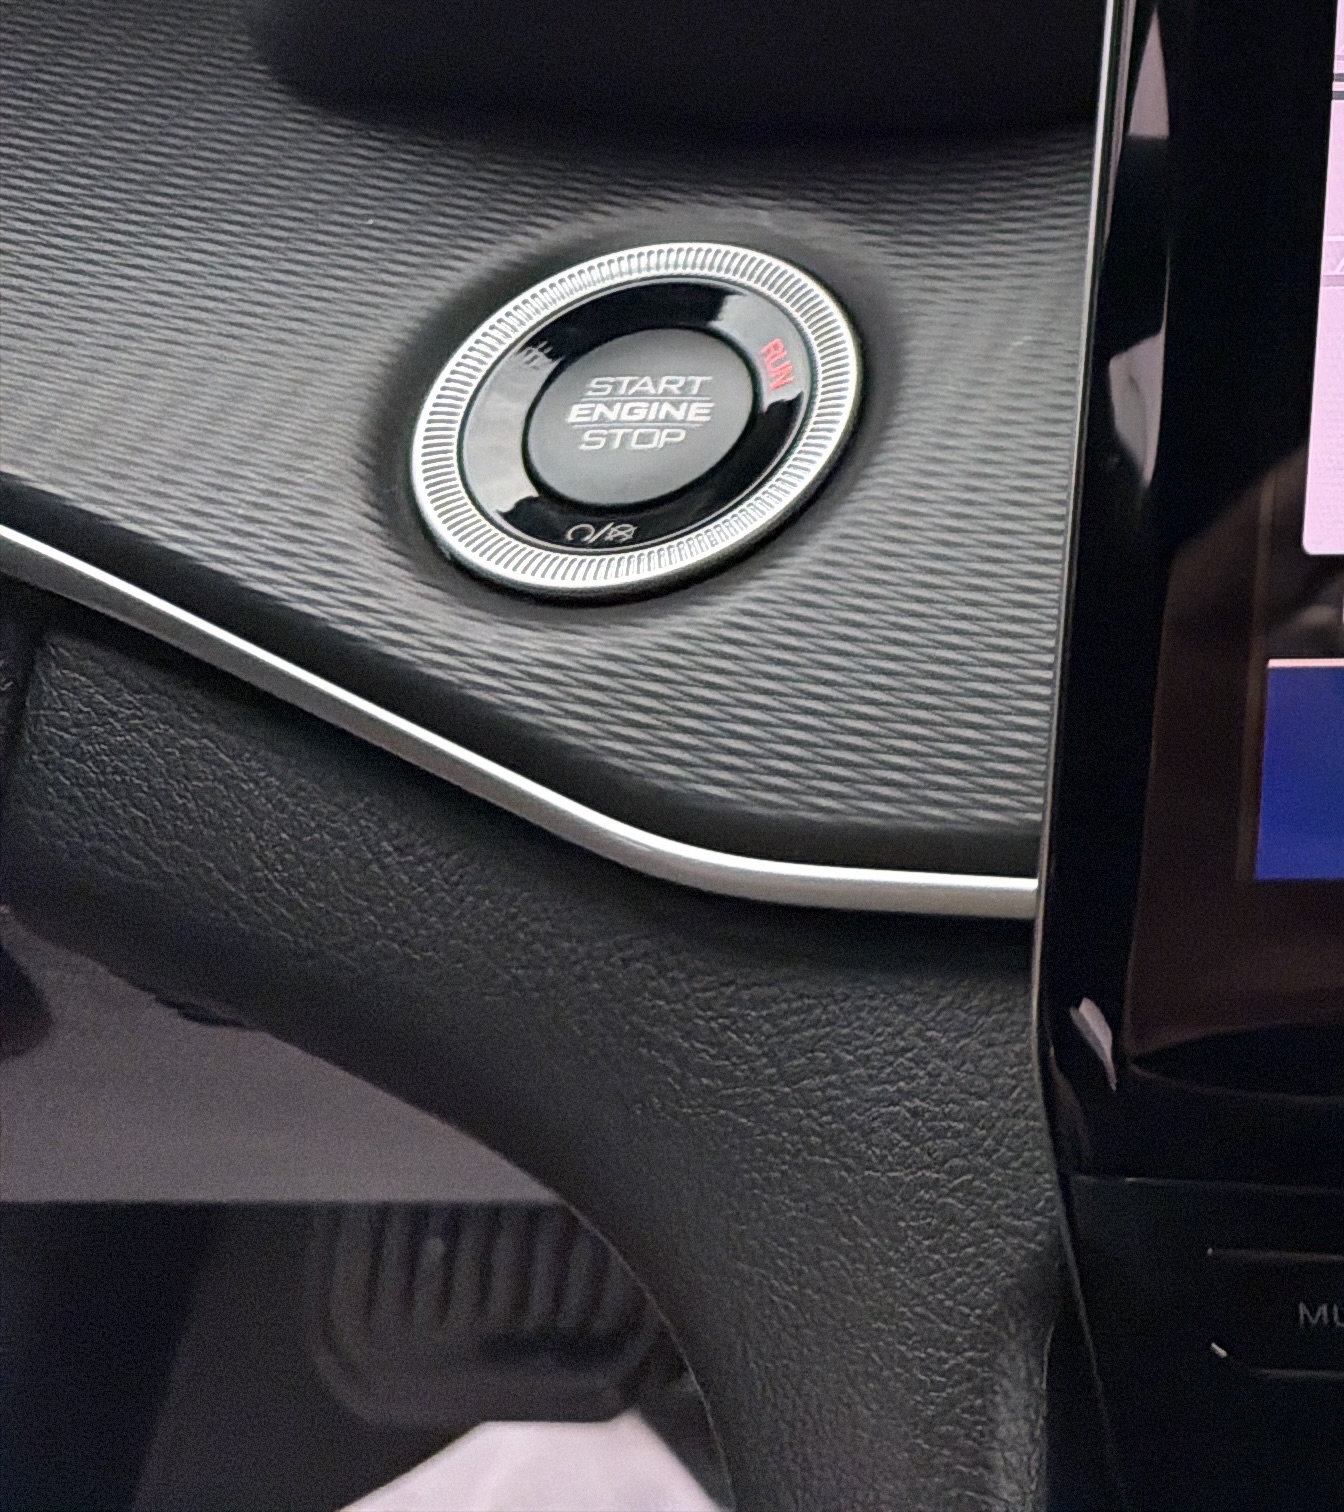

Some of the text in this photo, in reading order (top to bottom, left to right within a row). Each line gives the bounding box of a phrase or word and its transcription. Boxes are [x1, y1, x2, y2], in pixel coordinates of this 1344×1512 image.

[759, 338, 796, 392] RUN
[585, 375, 712, 397] START
[566, 401, 714, 424] ENGINE
[579, 428, 687, 452] STOP
